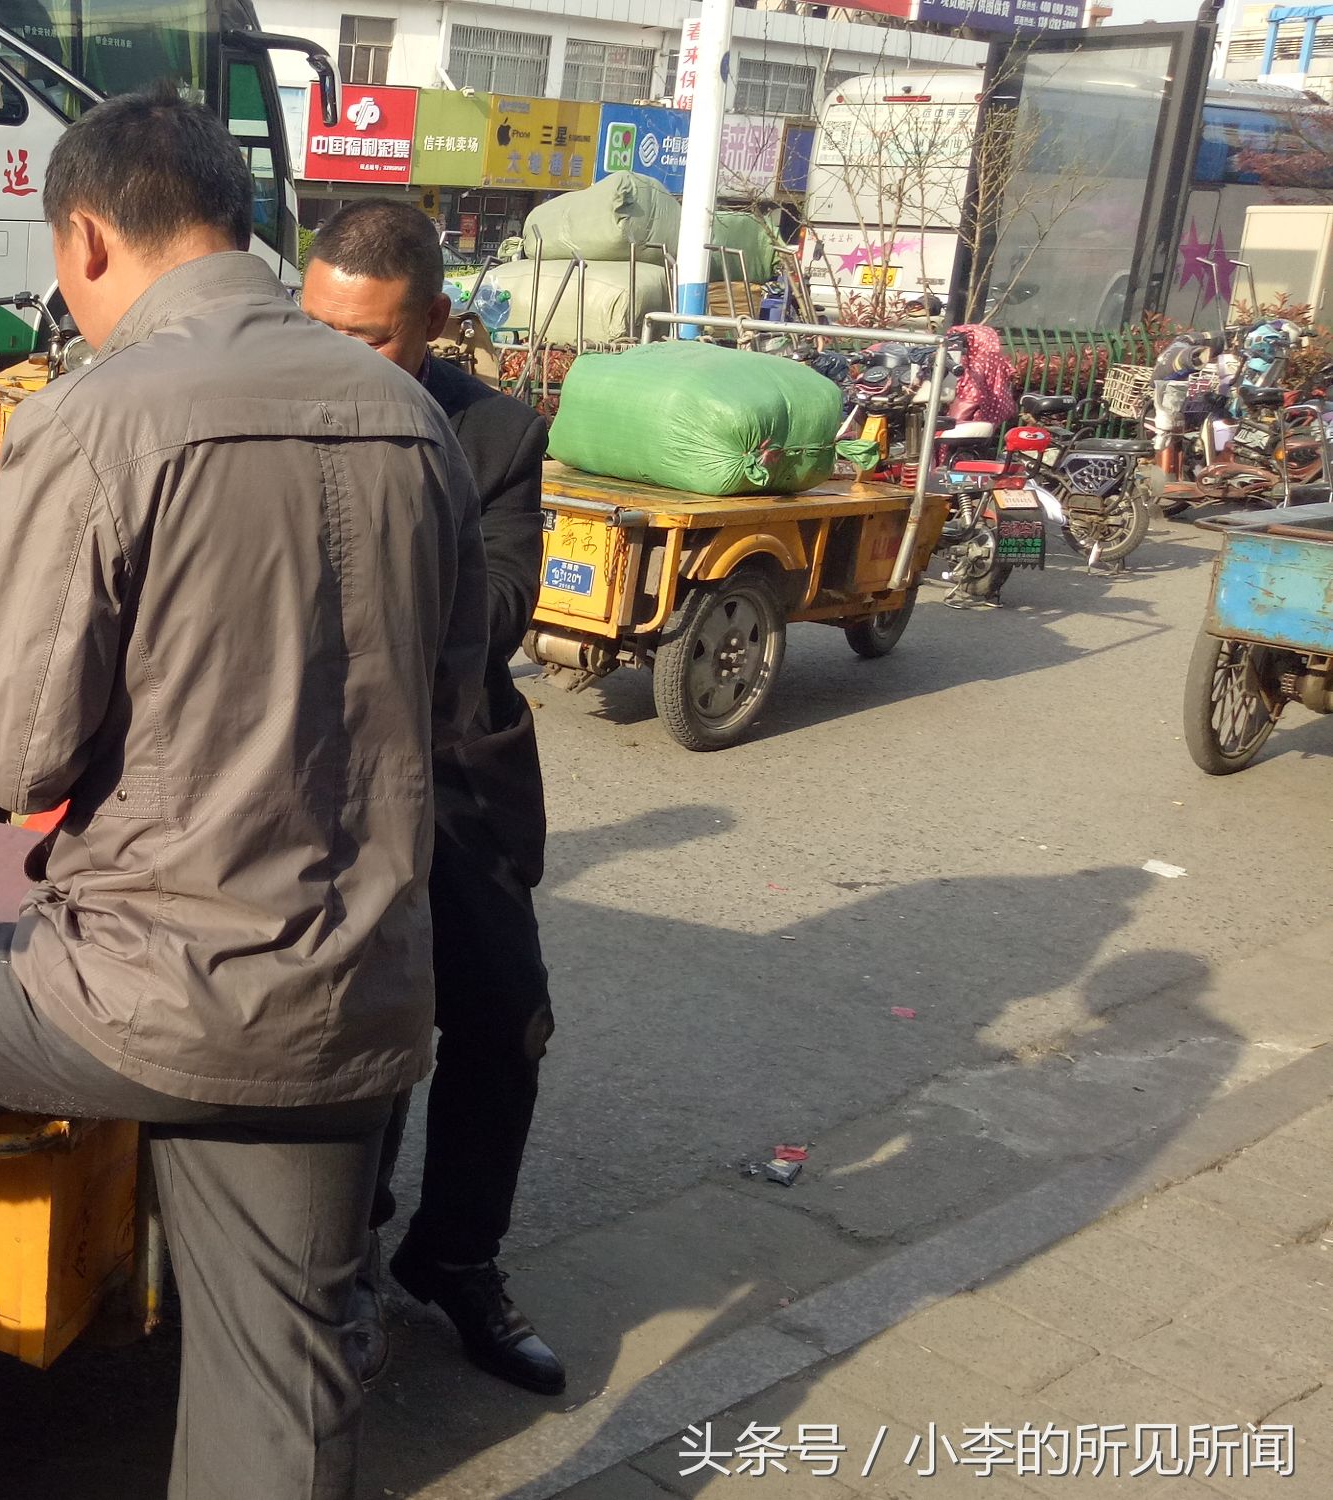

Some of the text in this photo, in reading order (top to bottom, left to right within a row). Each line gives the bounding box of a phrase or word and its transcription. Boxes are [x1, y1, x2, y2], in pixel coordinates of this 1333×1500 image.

[310, 135, 411, 159] 中国福利彩票
[423, 135, 480, 153] 信手机卖场
[540, 125, 568, 147] 三星
[507, 151, 585, 177] 大地通信
